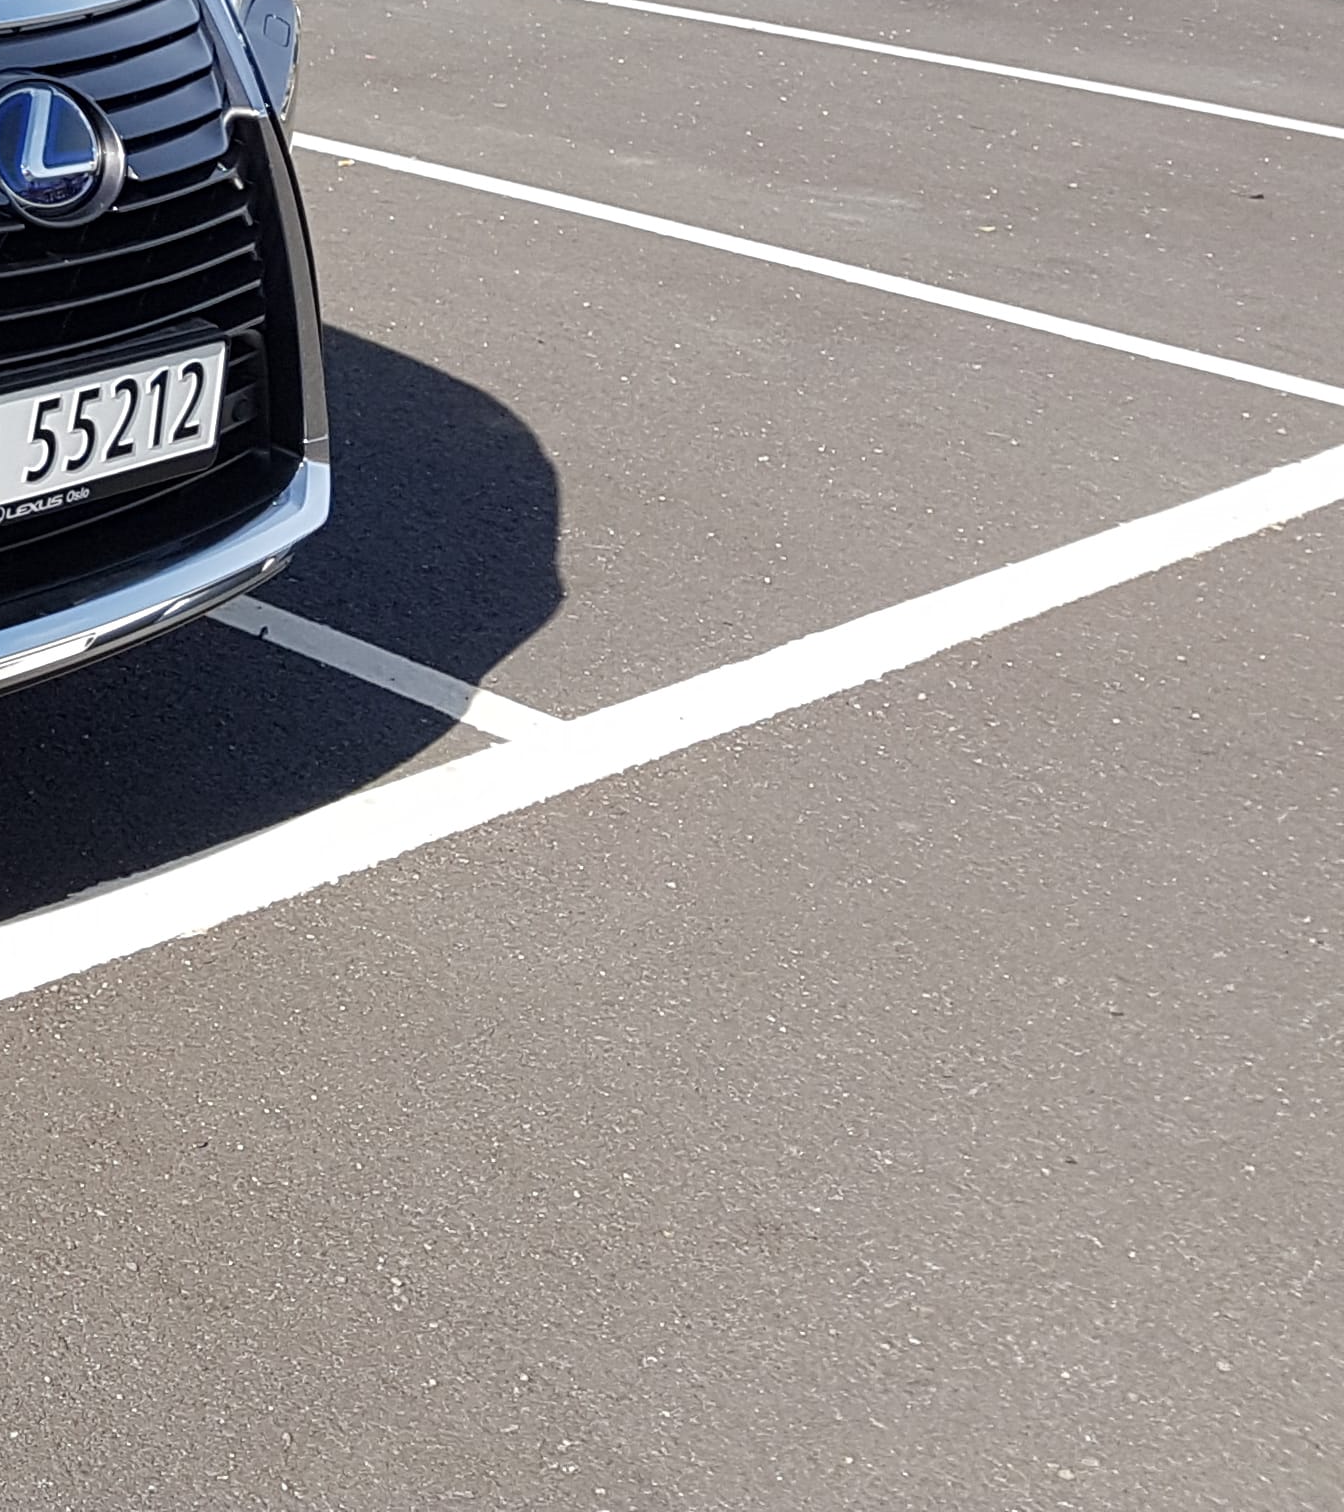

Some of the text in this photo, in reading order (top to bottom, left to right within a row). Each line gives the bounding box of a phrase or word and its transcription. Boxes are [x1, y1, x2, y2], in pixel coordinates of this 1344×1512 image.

[22, 360, 205, 484] 55212
[5, 494, 64, 520] LEXUS
[66, 487, 90, 503] Oslo
